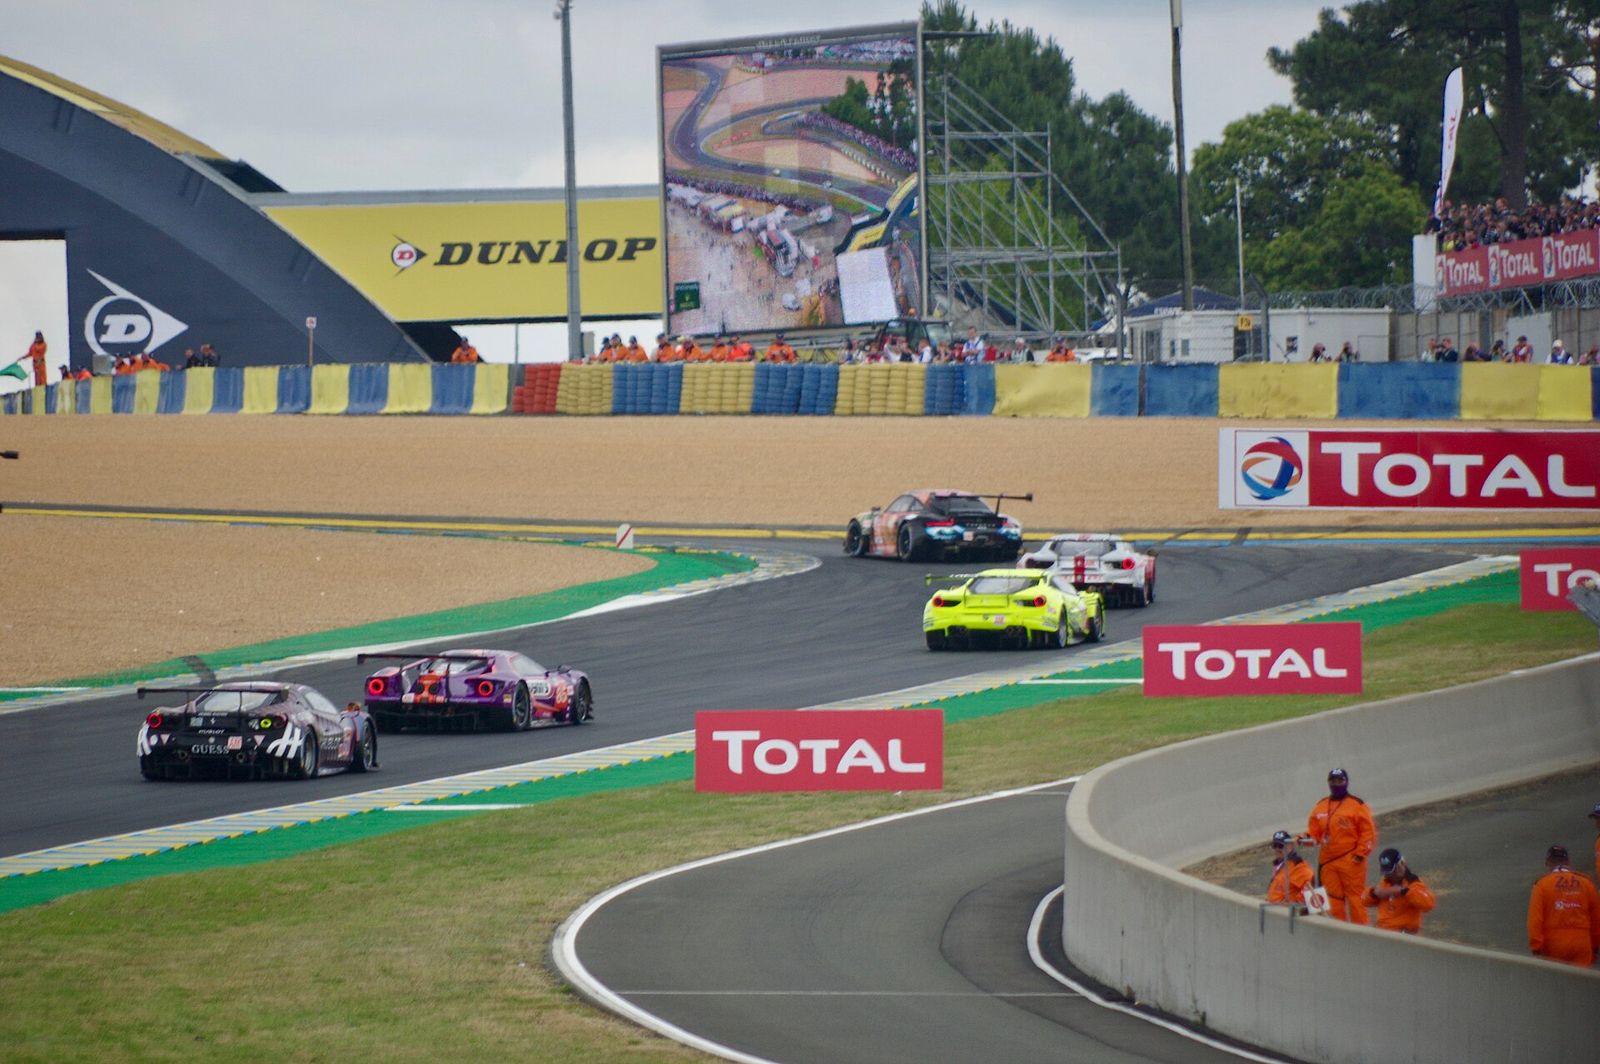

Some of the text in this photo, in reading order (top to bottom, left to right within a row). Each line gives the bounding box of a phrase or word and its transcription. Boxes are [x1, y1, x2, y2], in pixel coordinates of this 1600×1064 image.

[1500, 248, 1539, 279] TOTAL
[1554, 239, 1595, 270] TOTAL
[1446, 257, 1484, 287] TOTAL
[99, 313, 152, 344] D
[1321, 441, 1596, 498] TOTAL
[1158, 641, 1348, 681] TOTAL
[191, 743, 230, 755] GUESS
[711, 730, 926, 775] TOTAL
